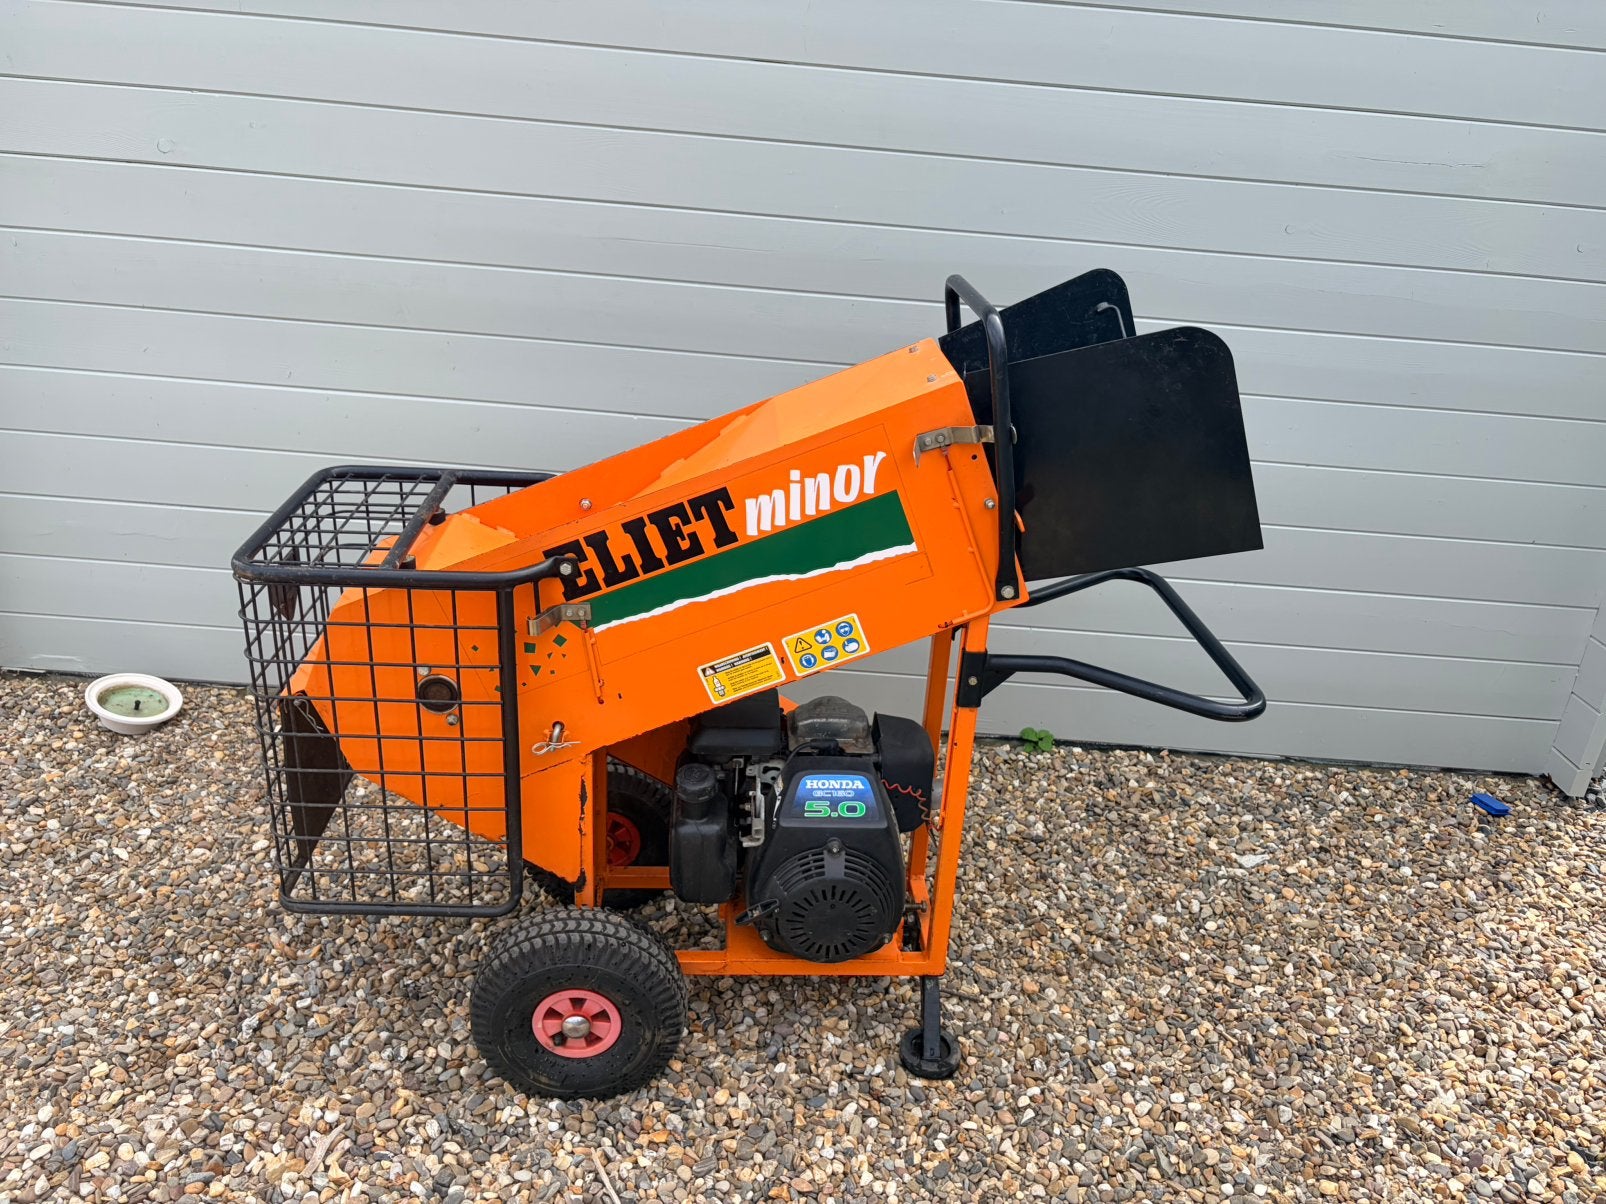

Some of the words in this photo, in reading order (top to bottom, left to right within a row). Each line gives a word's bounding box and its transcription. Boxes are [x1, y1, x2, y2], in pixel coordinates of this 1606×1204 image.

[542, 486, 739, 601] ELIET
[745, 451, 886, 536] minor
[805, 779, 864, 789] HONDA
[804, 801, 866, 817] 5.0
